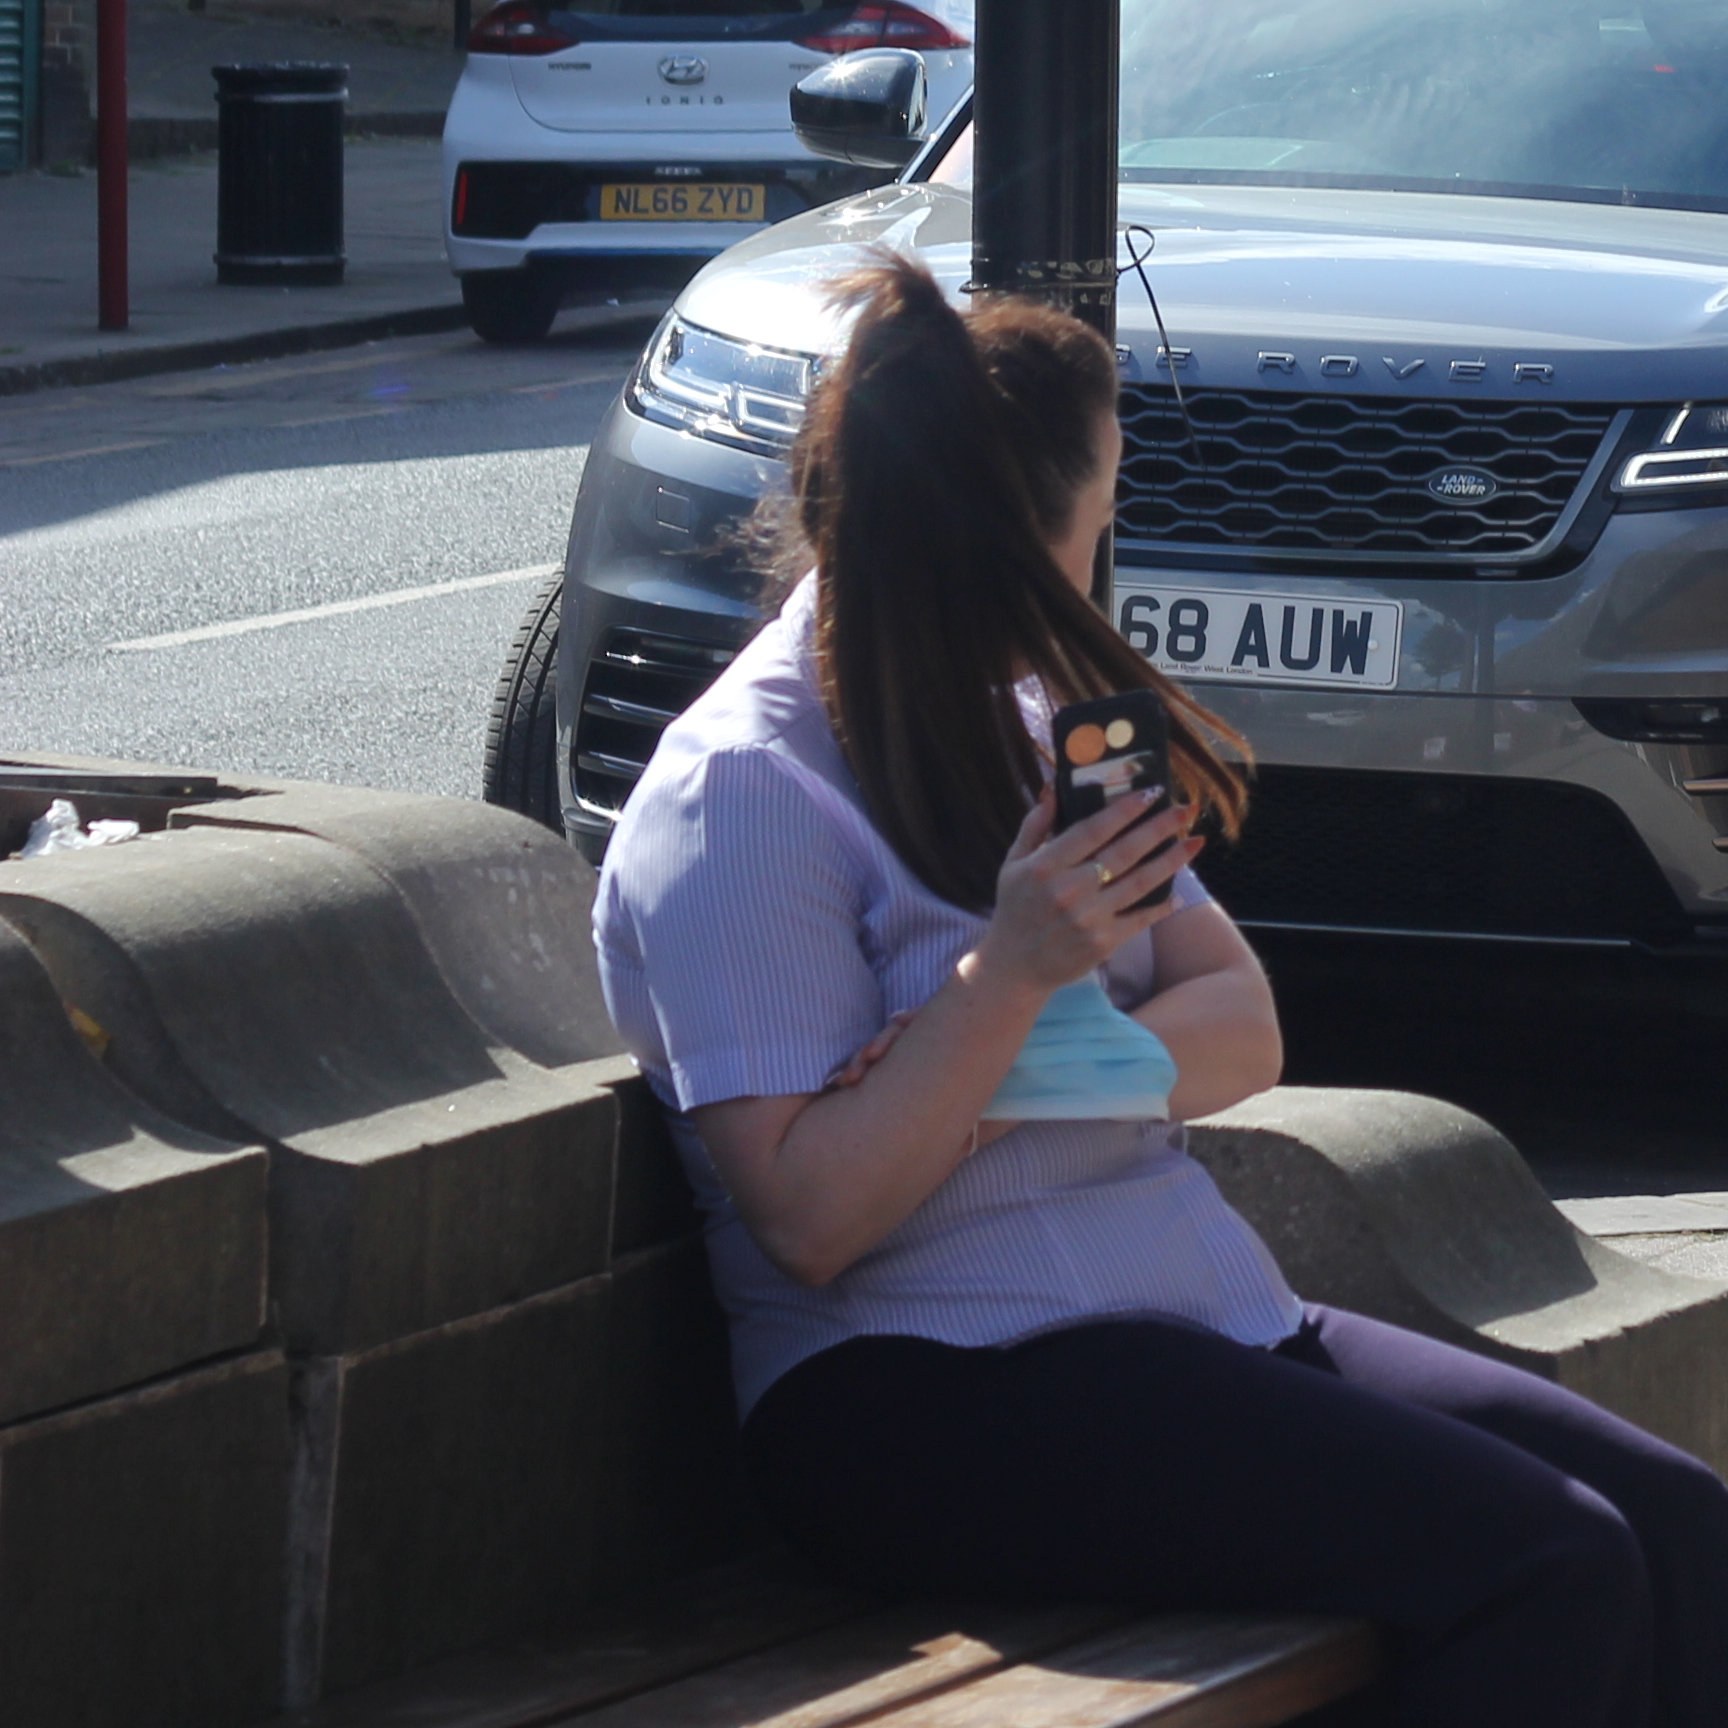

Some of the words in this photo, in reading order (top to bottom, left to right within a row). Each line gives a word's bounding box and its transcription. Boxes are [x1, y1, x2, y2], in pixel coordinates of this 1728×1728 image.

[614, 187, 689, 214] NL66
[698, 187, 753, 214] ZYD
[1257, 351, 1554, 385] ROVER
[1231, 603, 1373, 676] AUW
